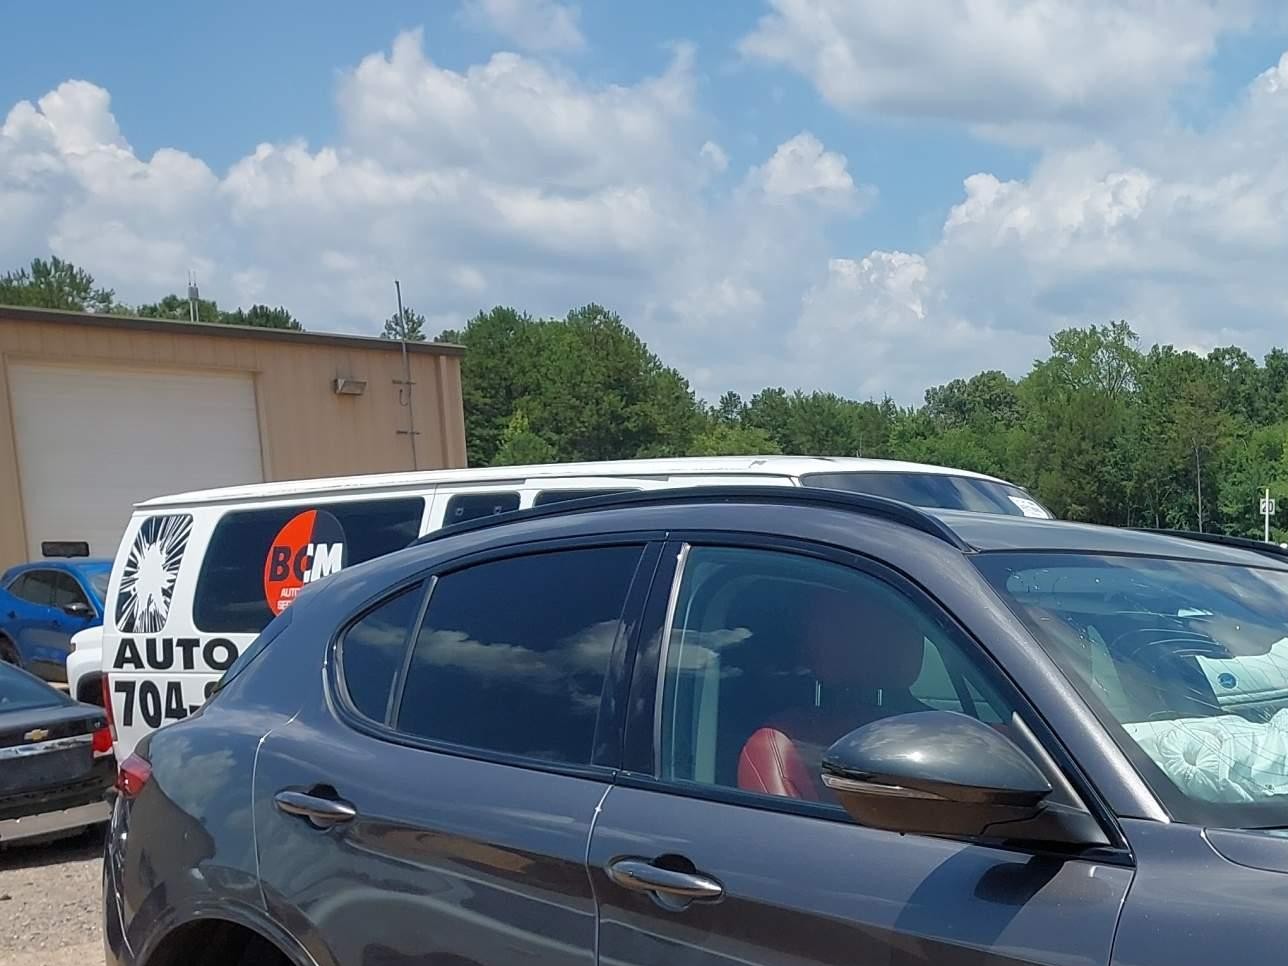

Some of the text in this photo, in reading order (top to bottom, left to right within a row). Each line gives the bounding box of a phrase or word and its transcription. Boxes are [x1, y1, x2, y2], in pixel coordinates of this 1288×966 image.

[1261, 500, 1274, 513] 20
[269, 542, 344, 583] BCM
[113, 637, 239, 670] AUTO
